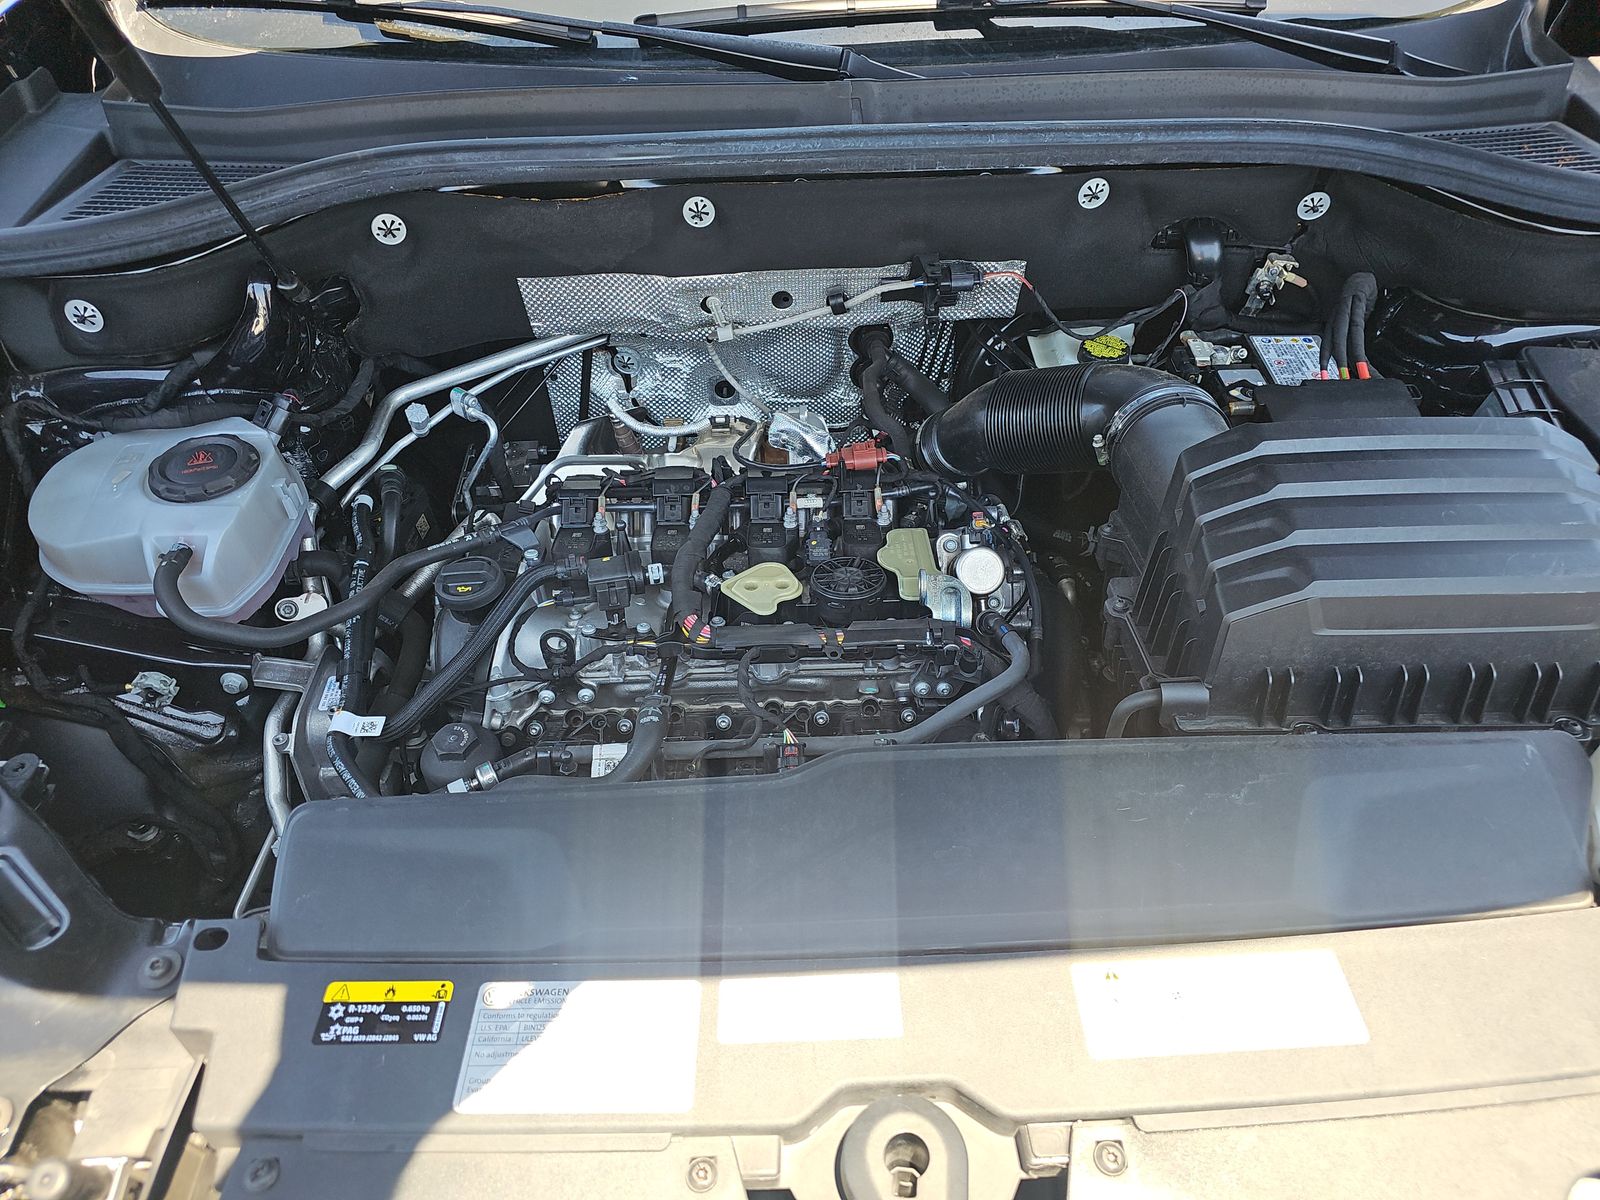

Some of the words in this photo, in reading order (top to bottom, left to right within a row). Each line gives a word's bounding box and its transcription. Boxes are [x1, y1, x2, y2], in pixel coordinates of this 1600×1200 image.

[482, 1012, 516, 1020] Conforms
[342, 1026, 360, 1034] PAG
[413, 1033, 426, 1041] VW
[426, 1033, 438, 1041] AG
